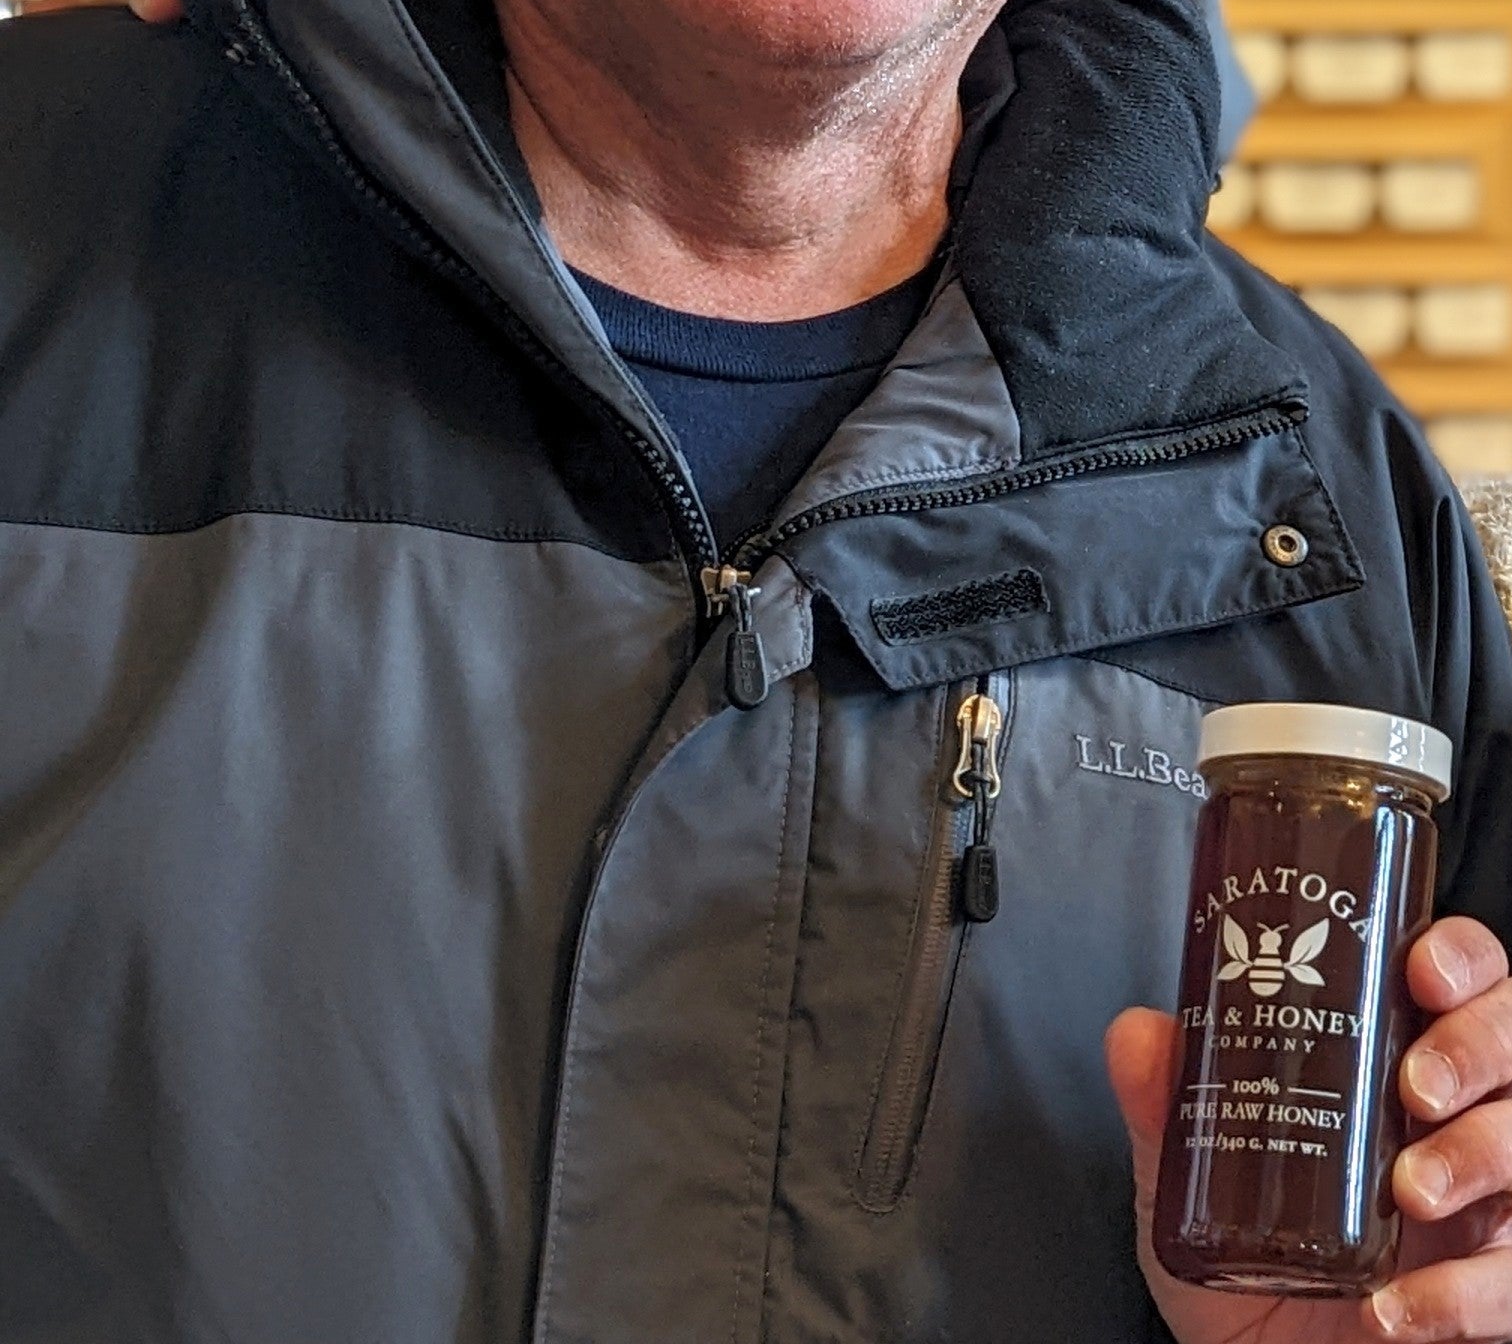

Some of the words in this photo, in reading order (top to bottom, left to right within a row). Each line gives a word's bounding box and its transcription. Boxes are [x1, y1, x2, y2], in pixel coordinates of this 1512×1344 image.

[1075, 734, 1209, 800] L.L.Bea
[1193, 866, 1373, 943] SARATOGA
[1182, 1005, 1216, 1030] TEA
[1224, 1006, 1243, 1027] &
[1253, 1004, 1364, 1038] HONEY
[1232, 1076, 1280, 1096] 100%
[1221, 1101, 1265, 1121] RAW
[1266, 1103, 1347, 1130] HONEY
[1267, 1139, 1297, 1153] NET
[1300, 1142, 1328, 1157] WT.
